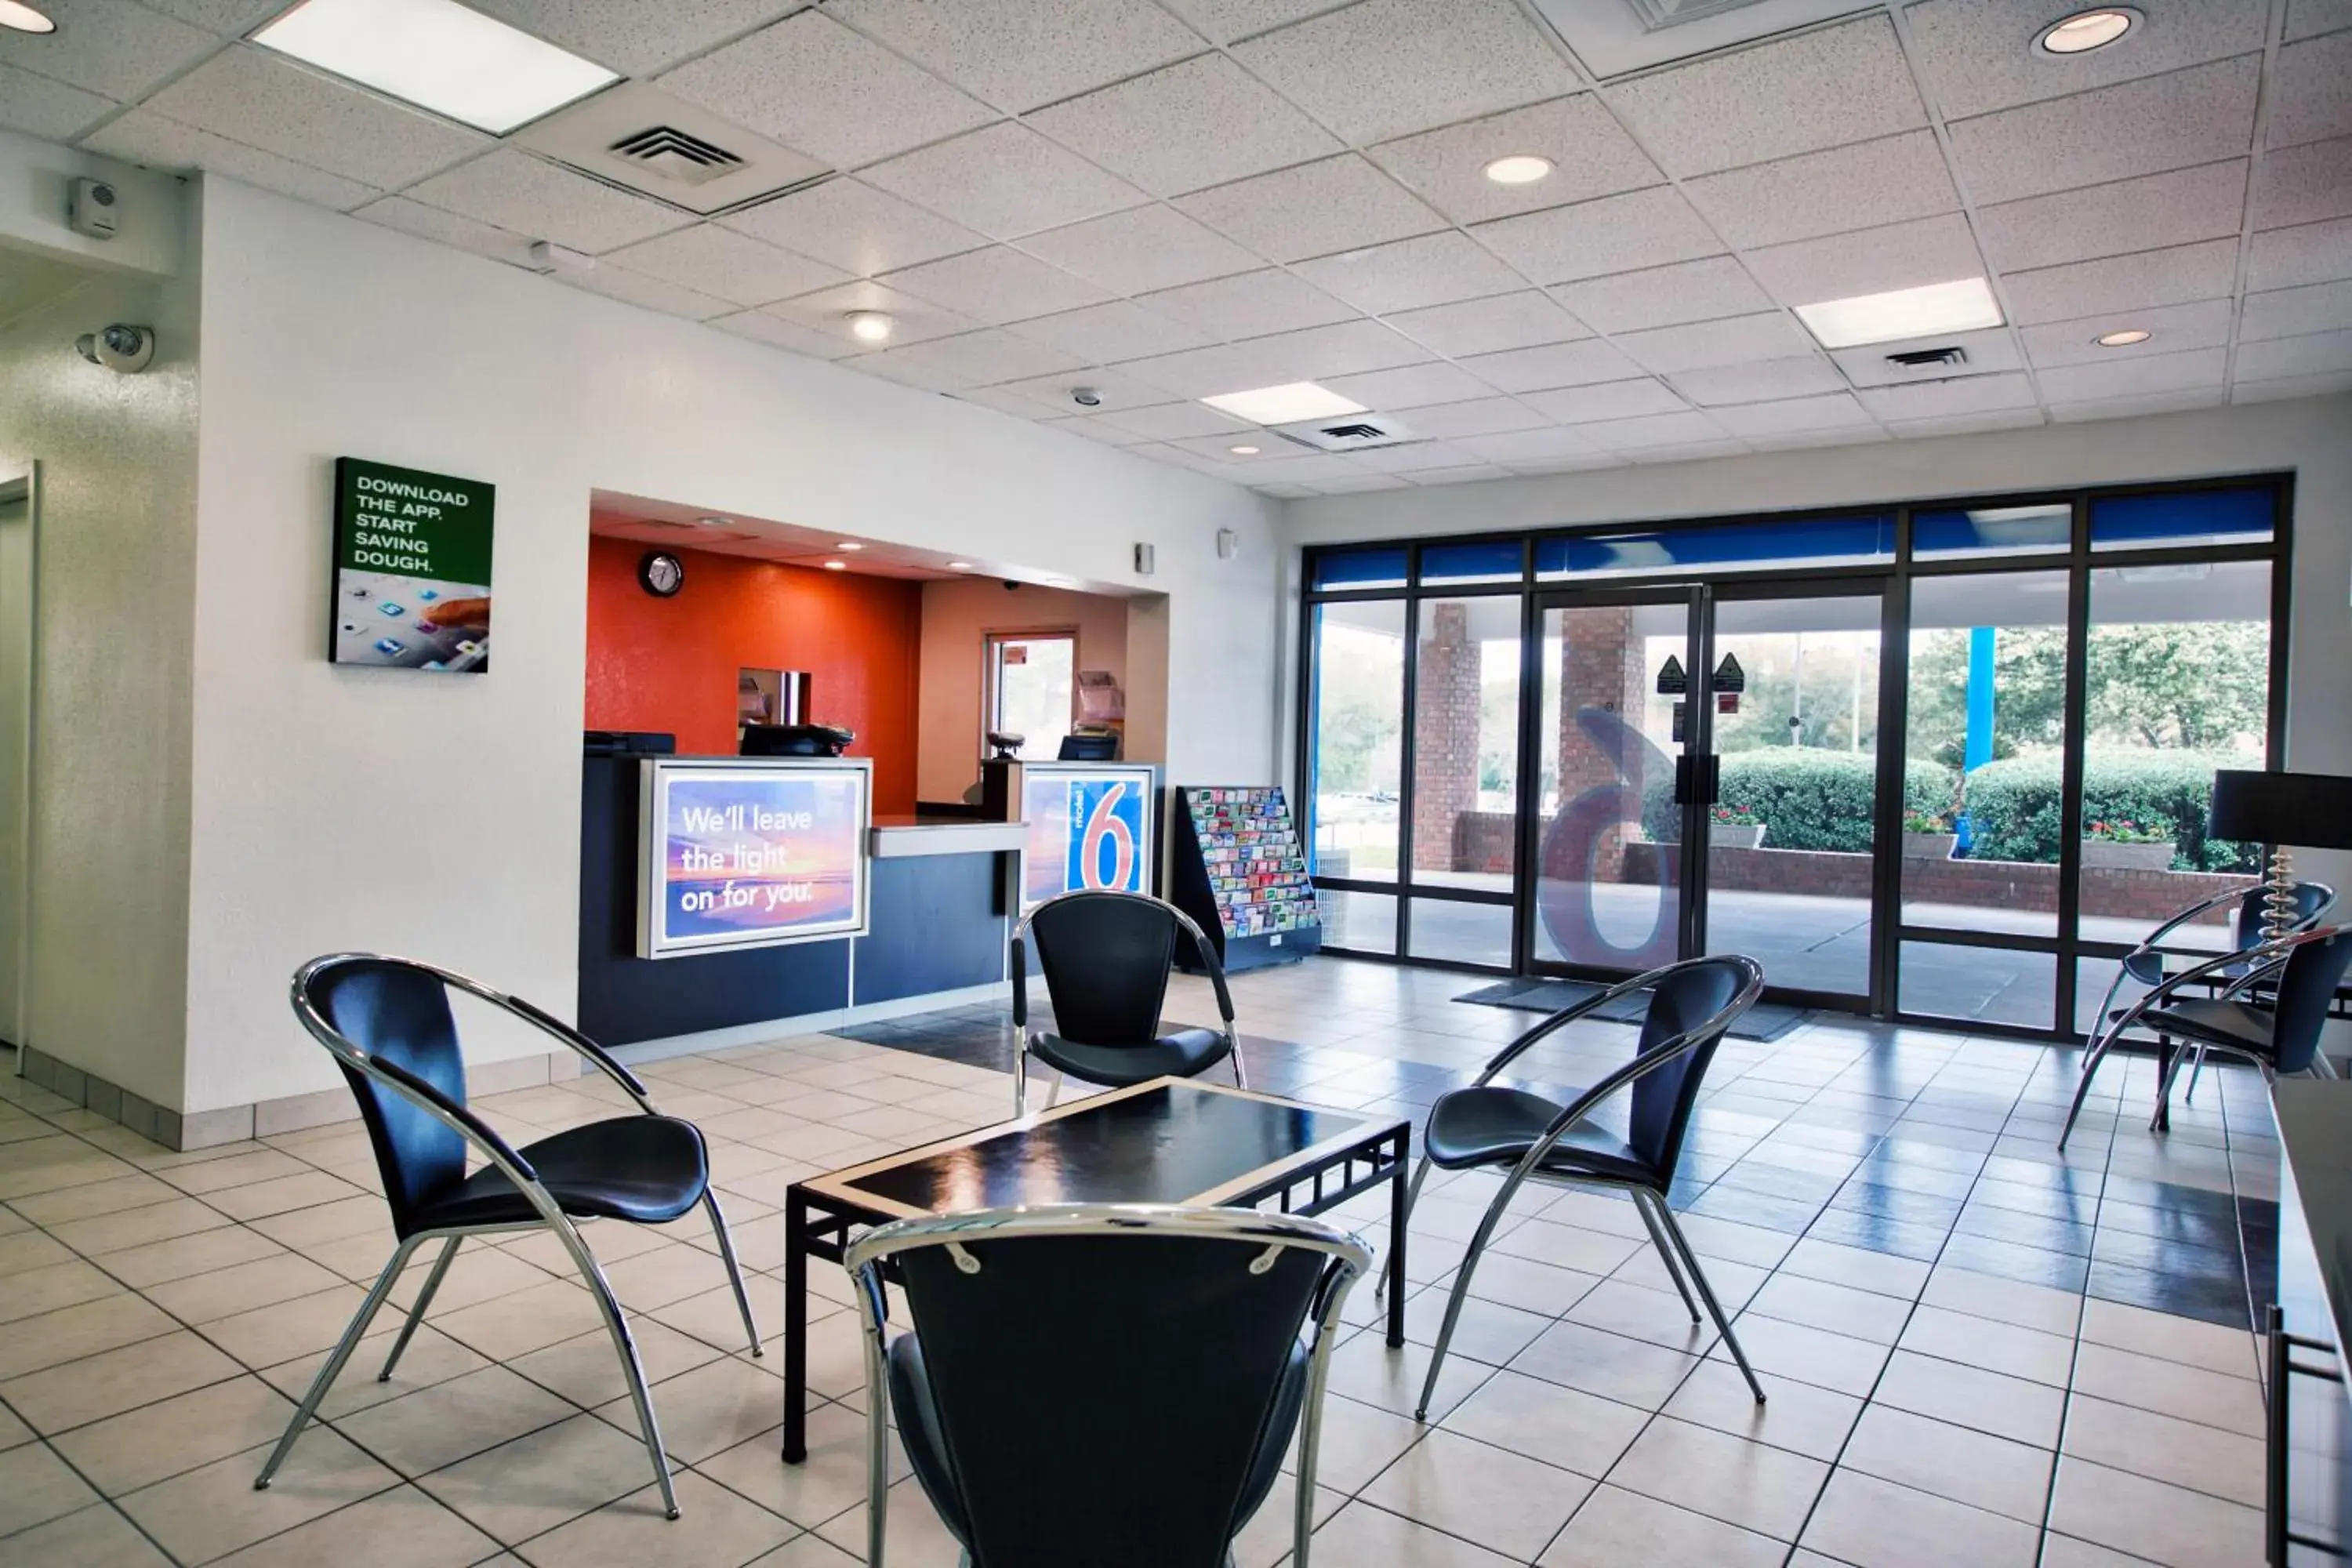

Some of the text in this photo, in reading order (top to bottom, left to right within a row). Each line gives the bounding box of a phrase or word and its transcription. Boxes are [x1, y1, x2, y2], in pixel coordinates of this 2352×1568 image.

[358, 476, 469, 506] DOWNLOAD
[357, 495, 443, 521] THE APP.
[356, 514, 417, 533] START
[355, 532, 429, 554] SAVING
[354, 550, 433, 572] DOUGH.
[753, 804, 812, 830] leave
[1080, 782, 1134, 891] 6
[681, 843, 786, 876] the light
[681, 891, 713, 911] on
[723, 880, 757, 907] for
